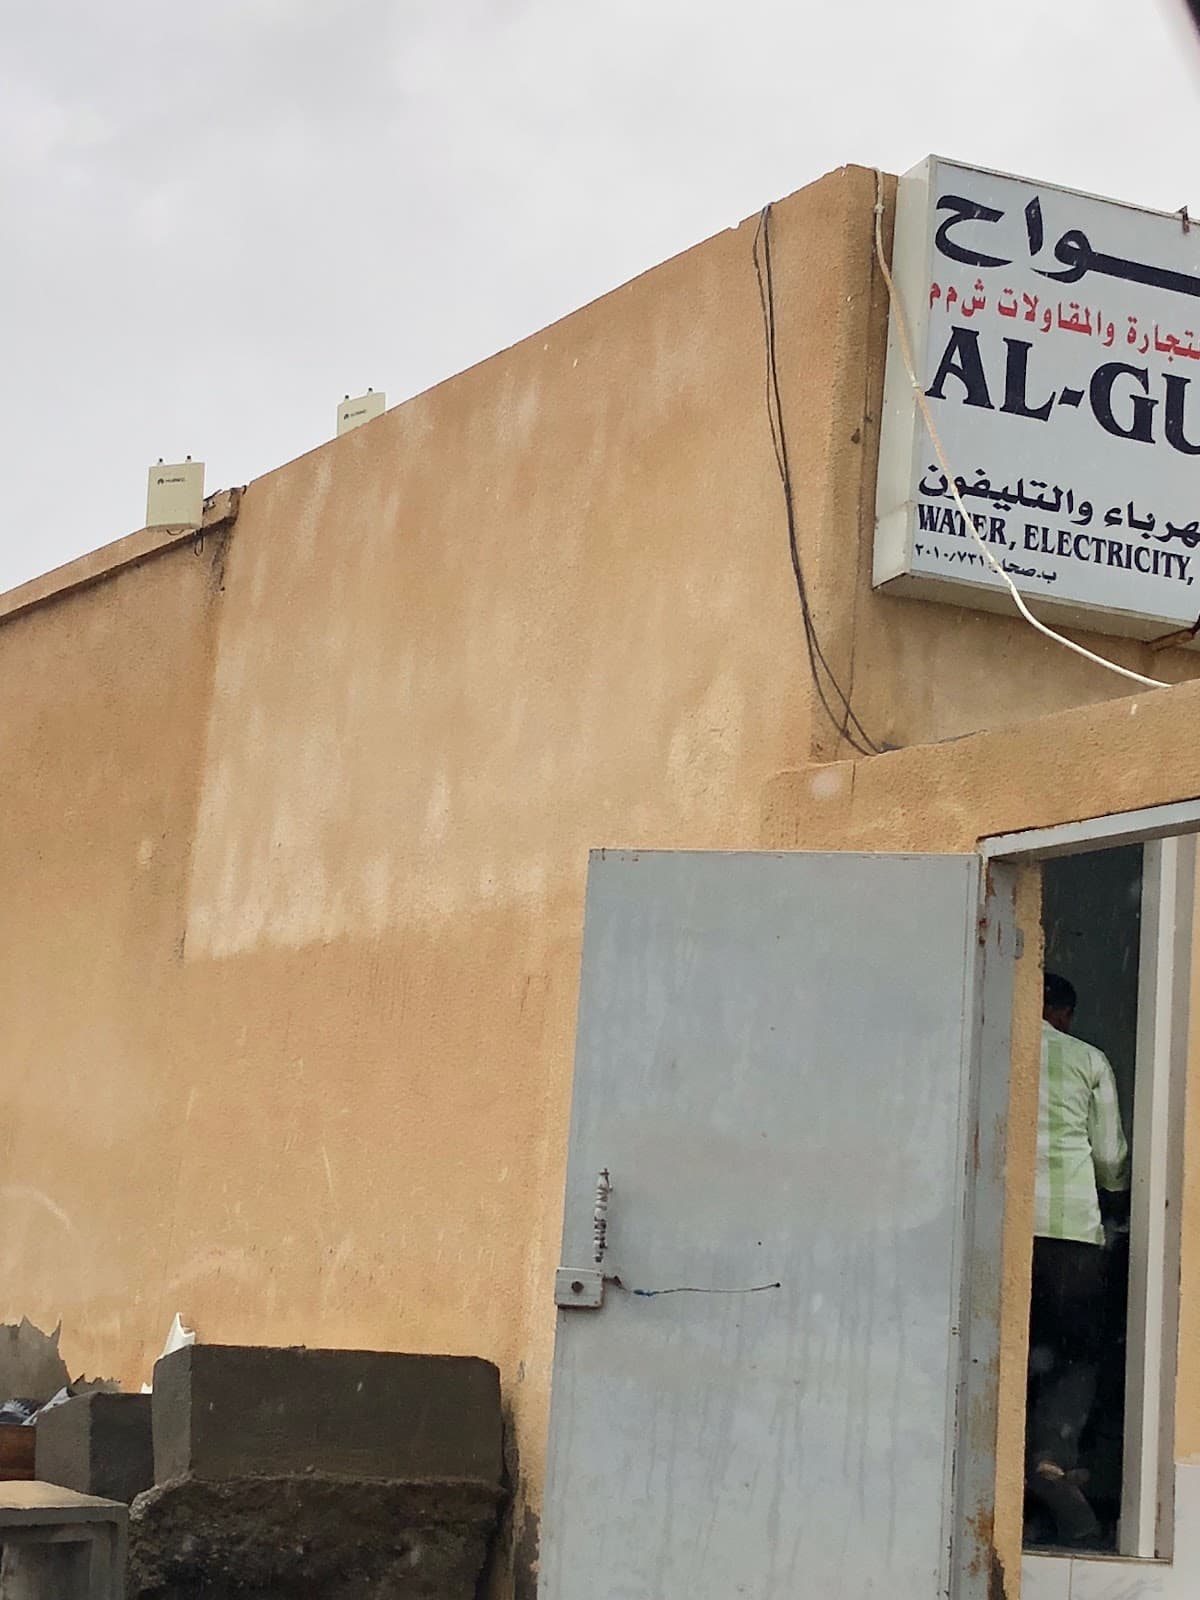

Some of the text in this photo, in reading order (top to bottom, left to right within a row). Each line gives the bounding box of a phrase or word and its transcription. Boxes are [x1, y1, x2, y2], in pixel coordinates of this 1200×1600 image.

[935, 194, 1200, 298] واح
[997, 288, 1115, 347] والمقاولات
[1126, 315, 1200, 362] تجارة
[918, 464, 1093, 526] والتليفون
[917, 503, 1194, 586] WATER, ELECTRICITY,
